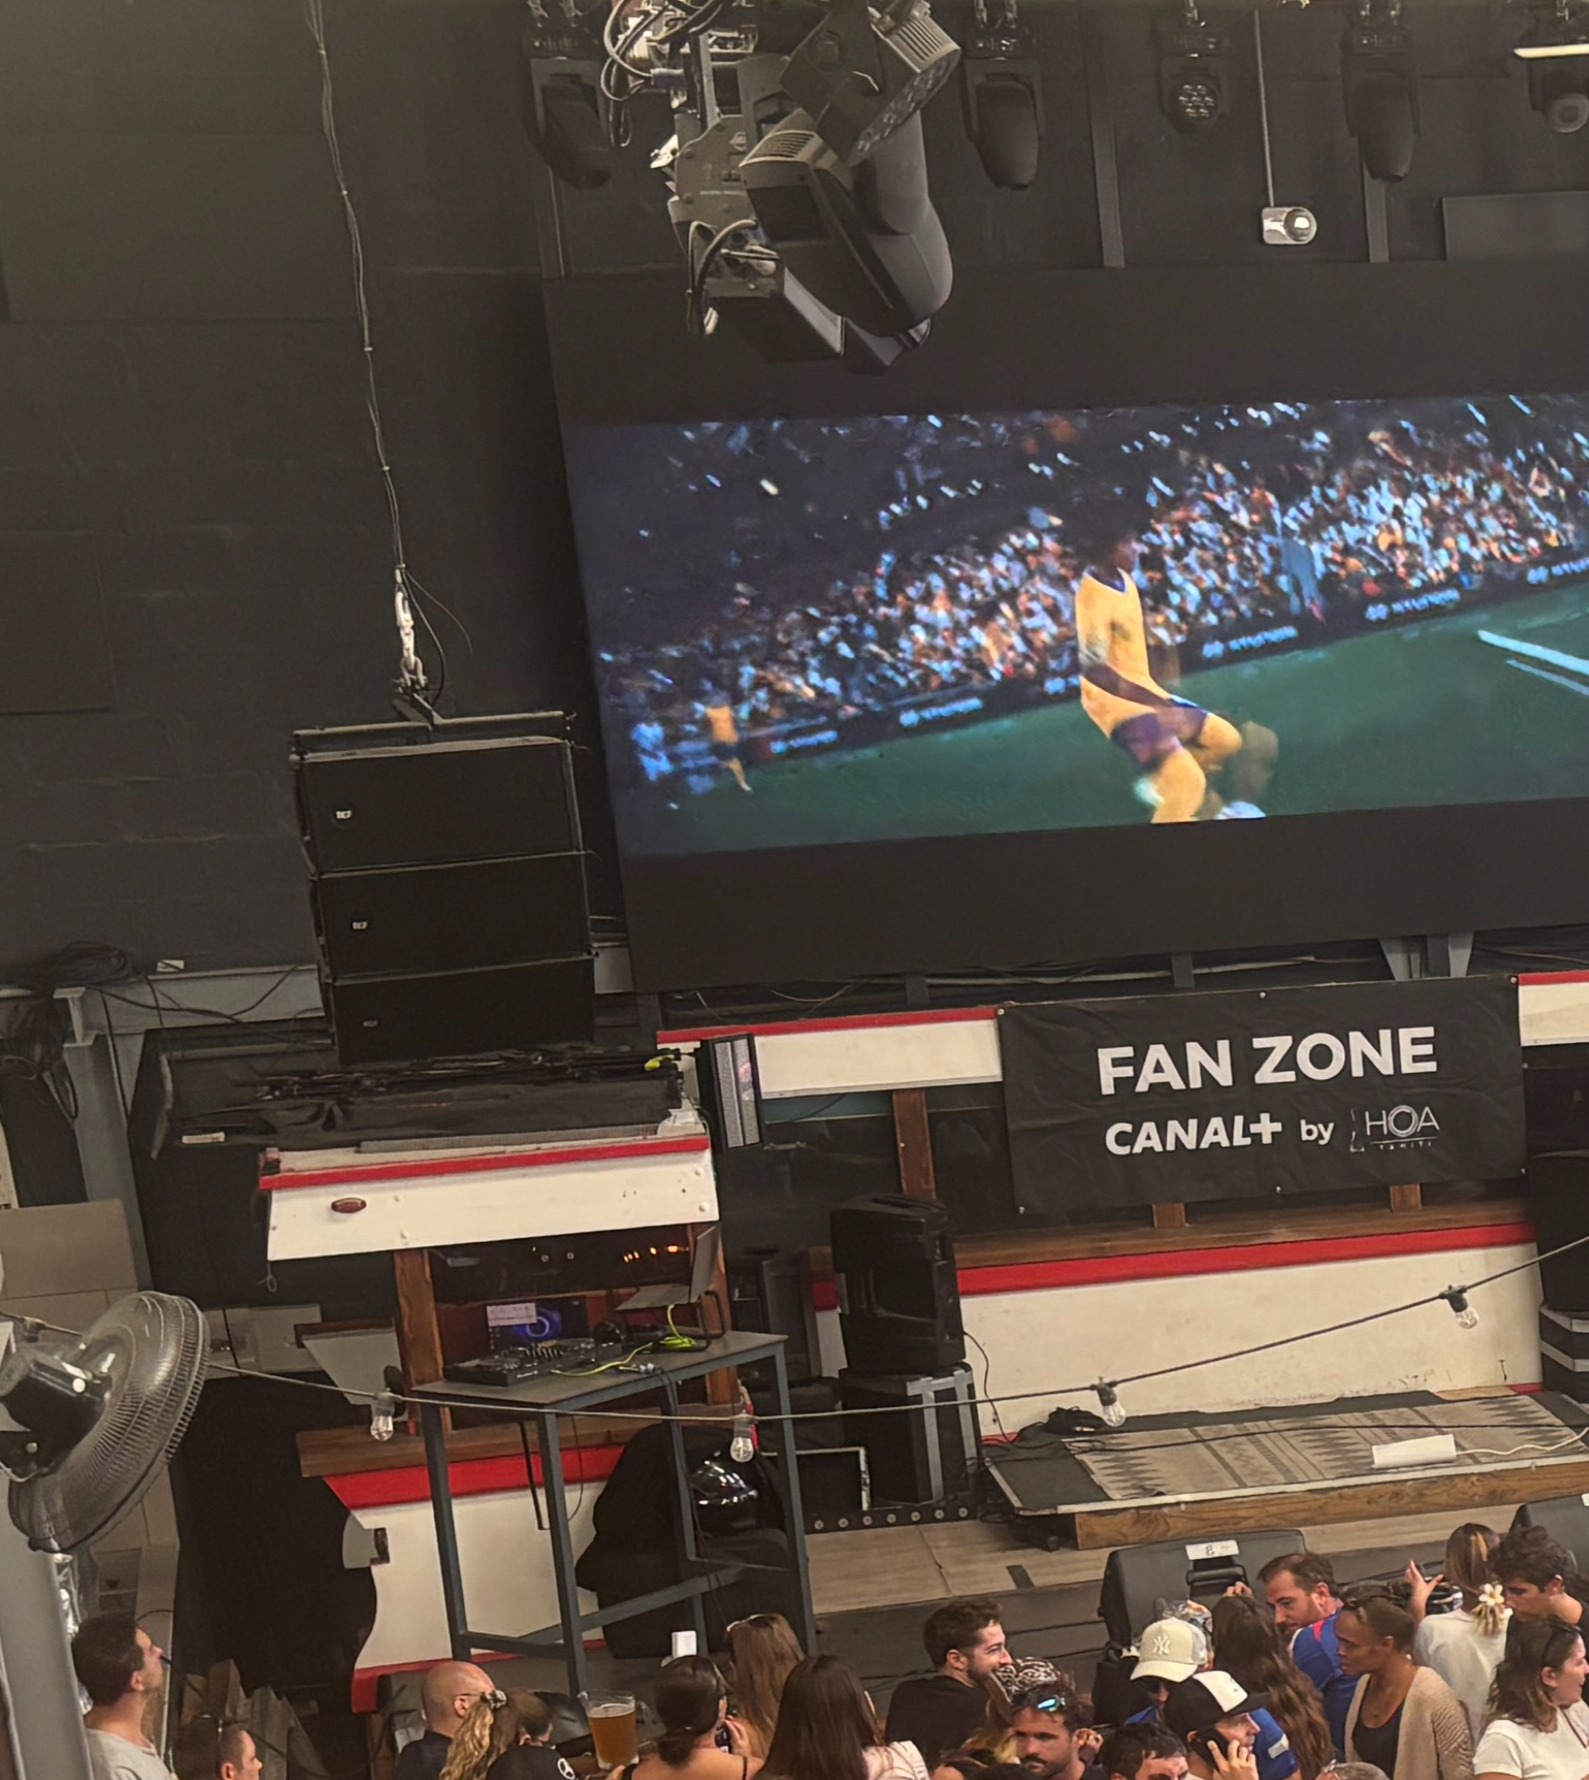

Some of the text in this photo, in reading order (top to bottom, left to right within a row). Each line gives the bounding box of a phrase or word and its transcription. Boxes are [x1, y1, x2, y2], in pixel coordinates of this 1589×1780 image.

[1098, 1026, 1437, 1095] FAN ZONE
[1105, 1105, 1440, 1155] CANAL+ by HOA
